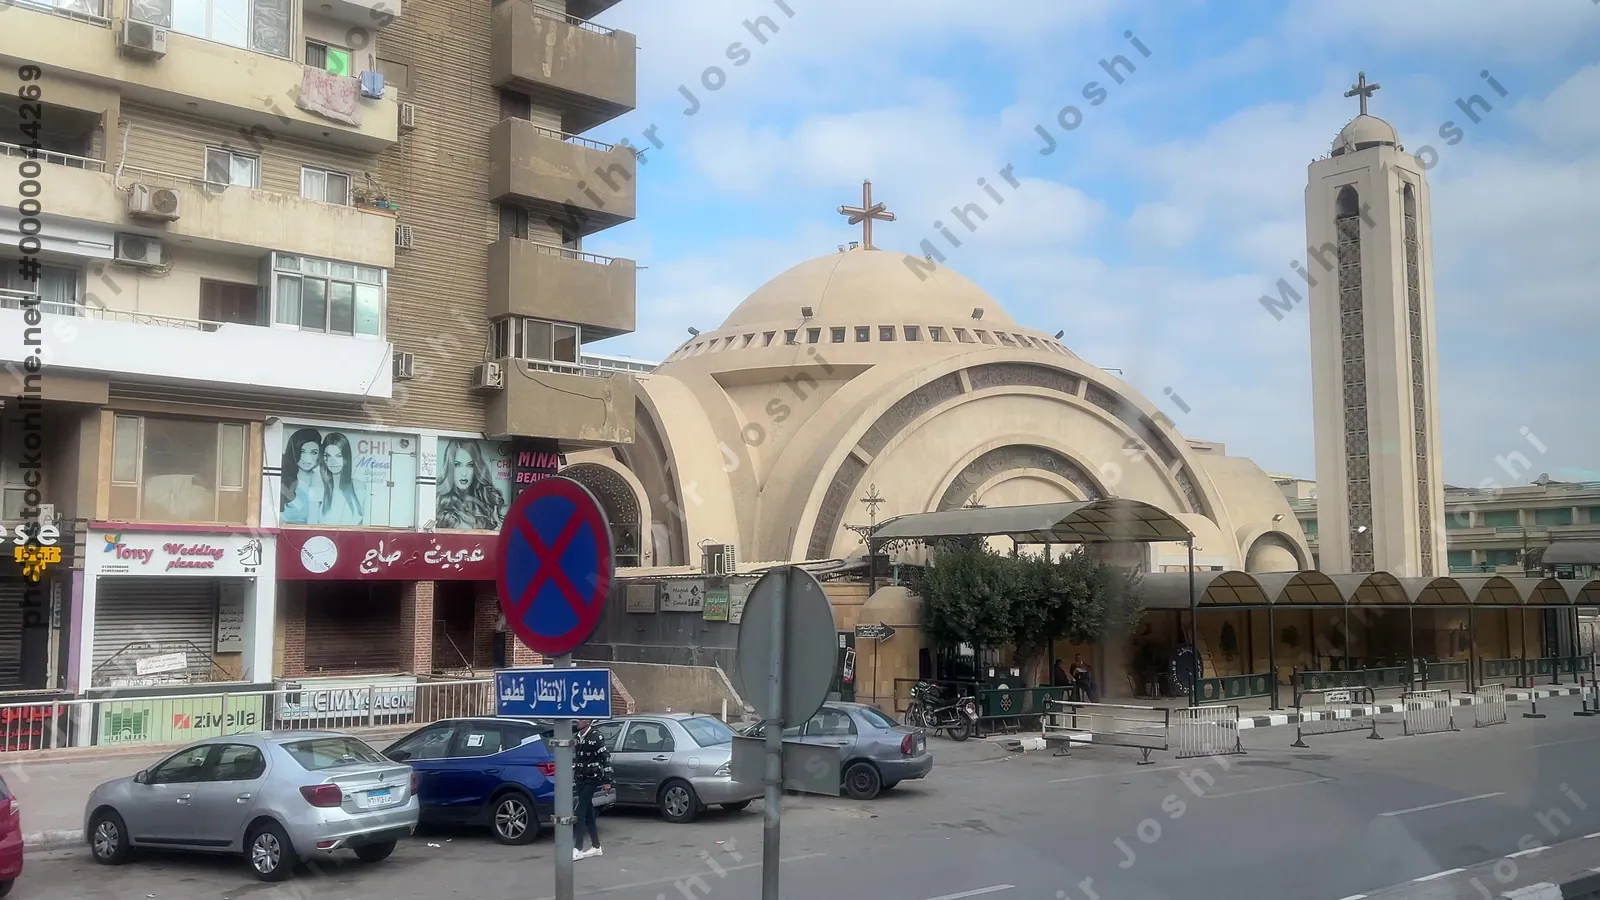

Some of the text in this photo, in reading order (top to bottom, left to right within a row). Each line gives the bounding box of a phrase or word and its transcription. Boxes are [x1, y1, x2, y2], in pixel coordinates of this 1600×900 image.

[357, 439, 387, 455] CHI
[356, 456, 390, 469] Mina
[517, 451, 557, 468] MINA
[114, 543, 154, 565] Tony
[162, 542, 225, 561] Wedding
[164, 557, 215, 572] planner
[570, 680, 605, 712] ممنوع
[194, 710, 256, 729] zivella
